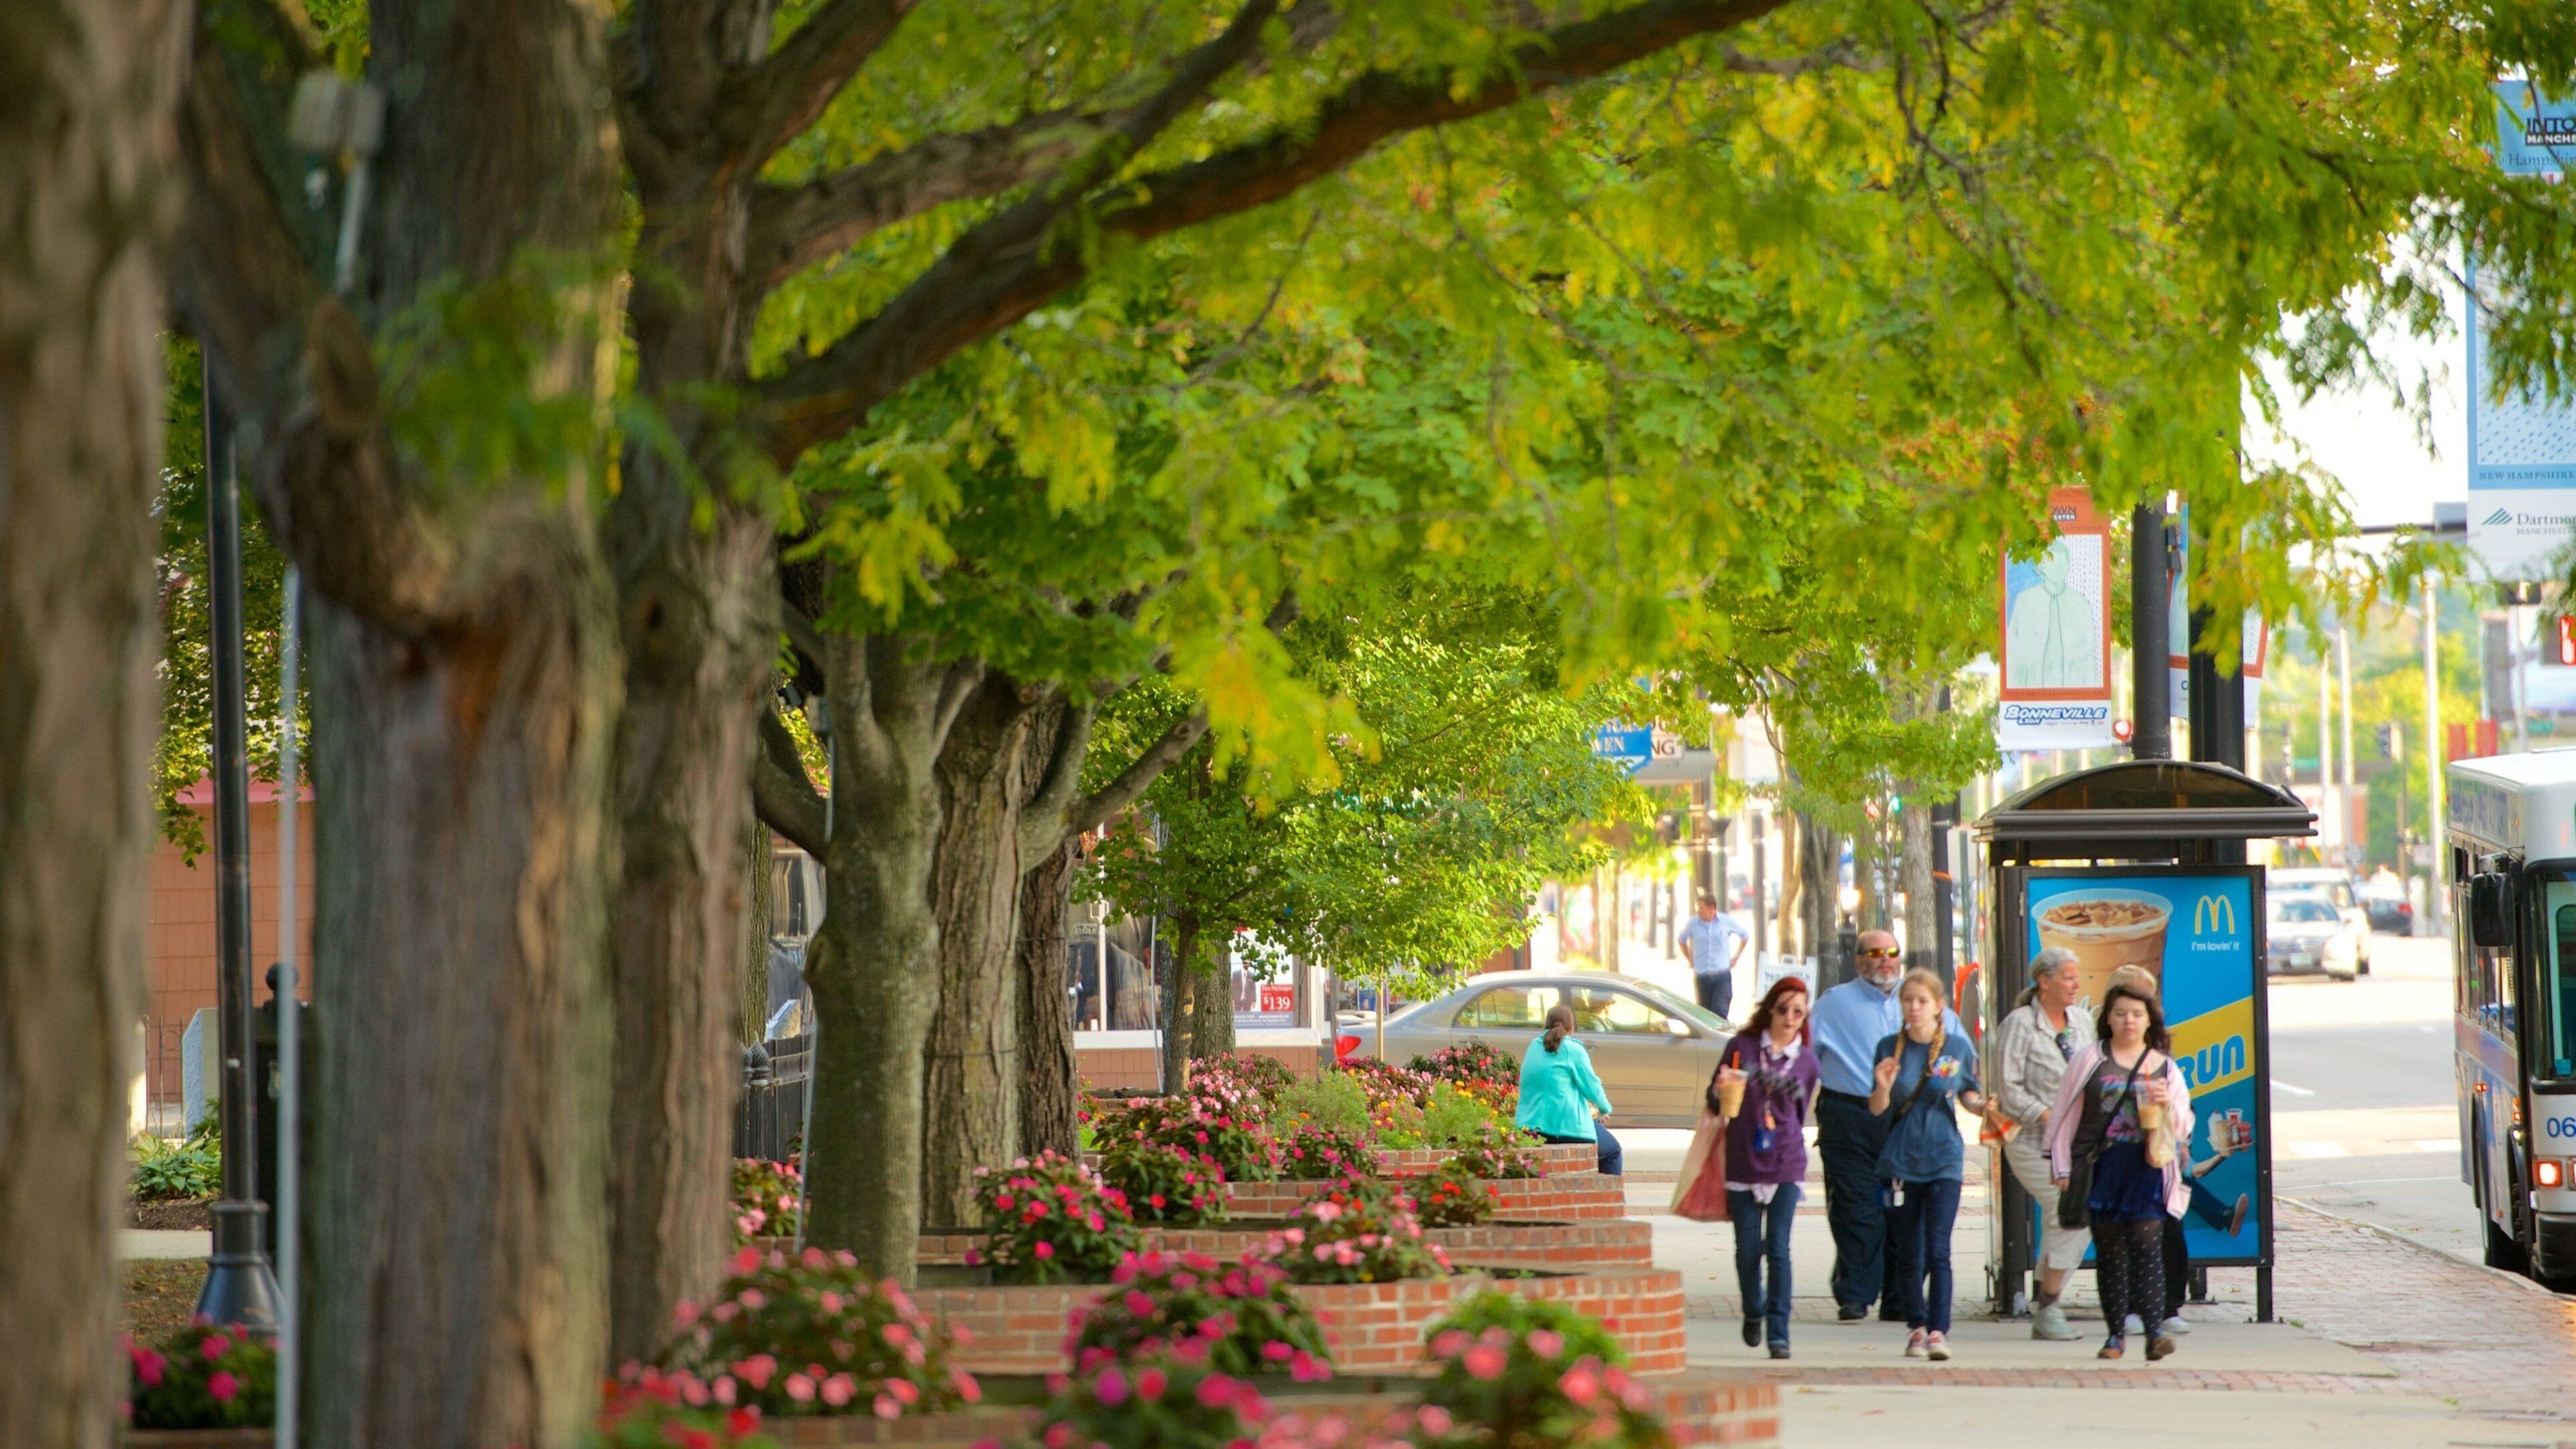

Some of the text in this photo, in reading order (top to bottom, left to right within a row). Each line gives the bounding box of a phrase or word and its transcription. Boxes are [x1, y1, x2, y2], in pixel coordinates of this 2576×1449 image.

[2508, 471, 2575, 479] HAMPSHIRE
[2004, 704, 2106, 720] BONNEVILLE
[1263, 996, 1291, 1010] $139
